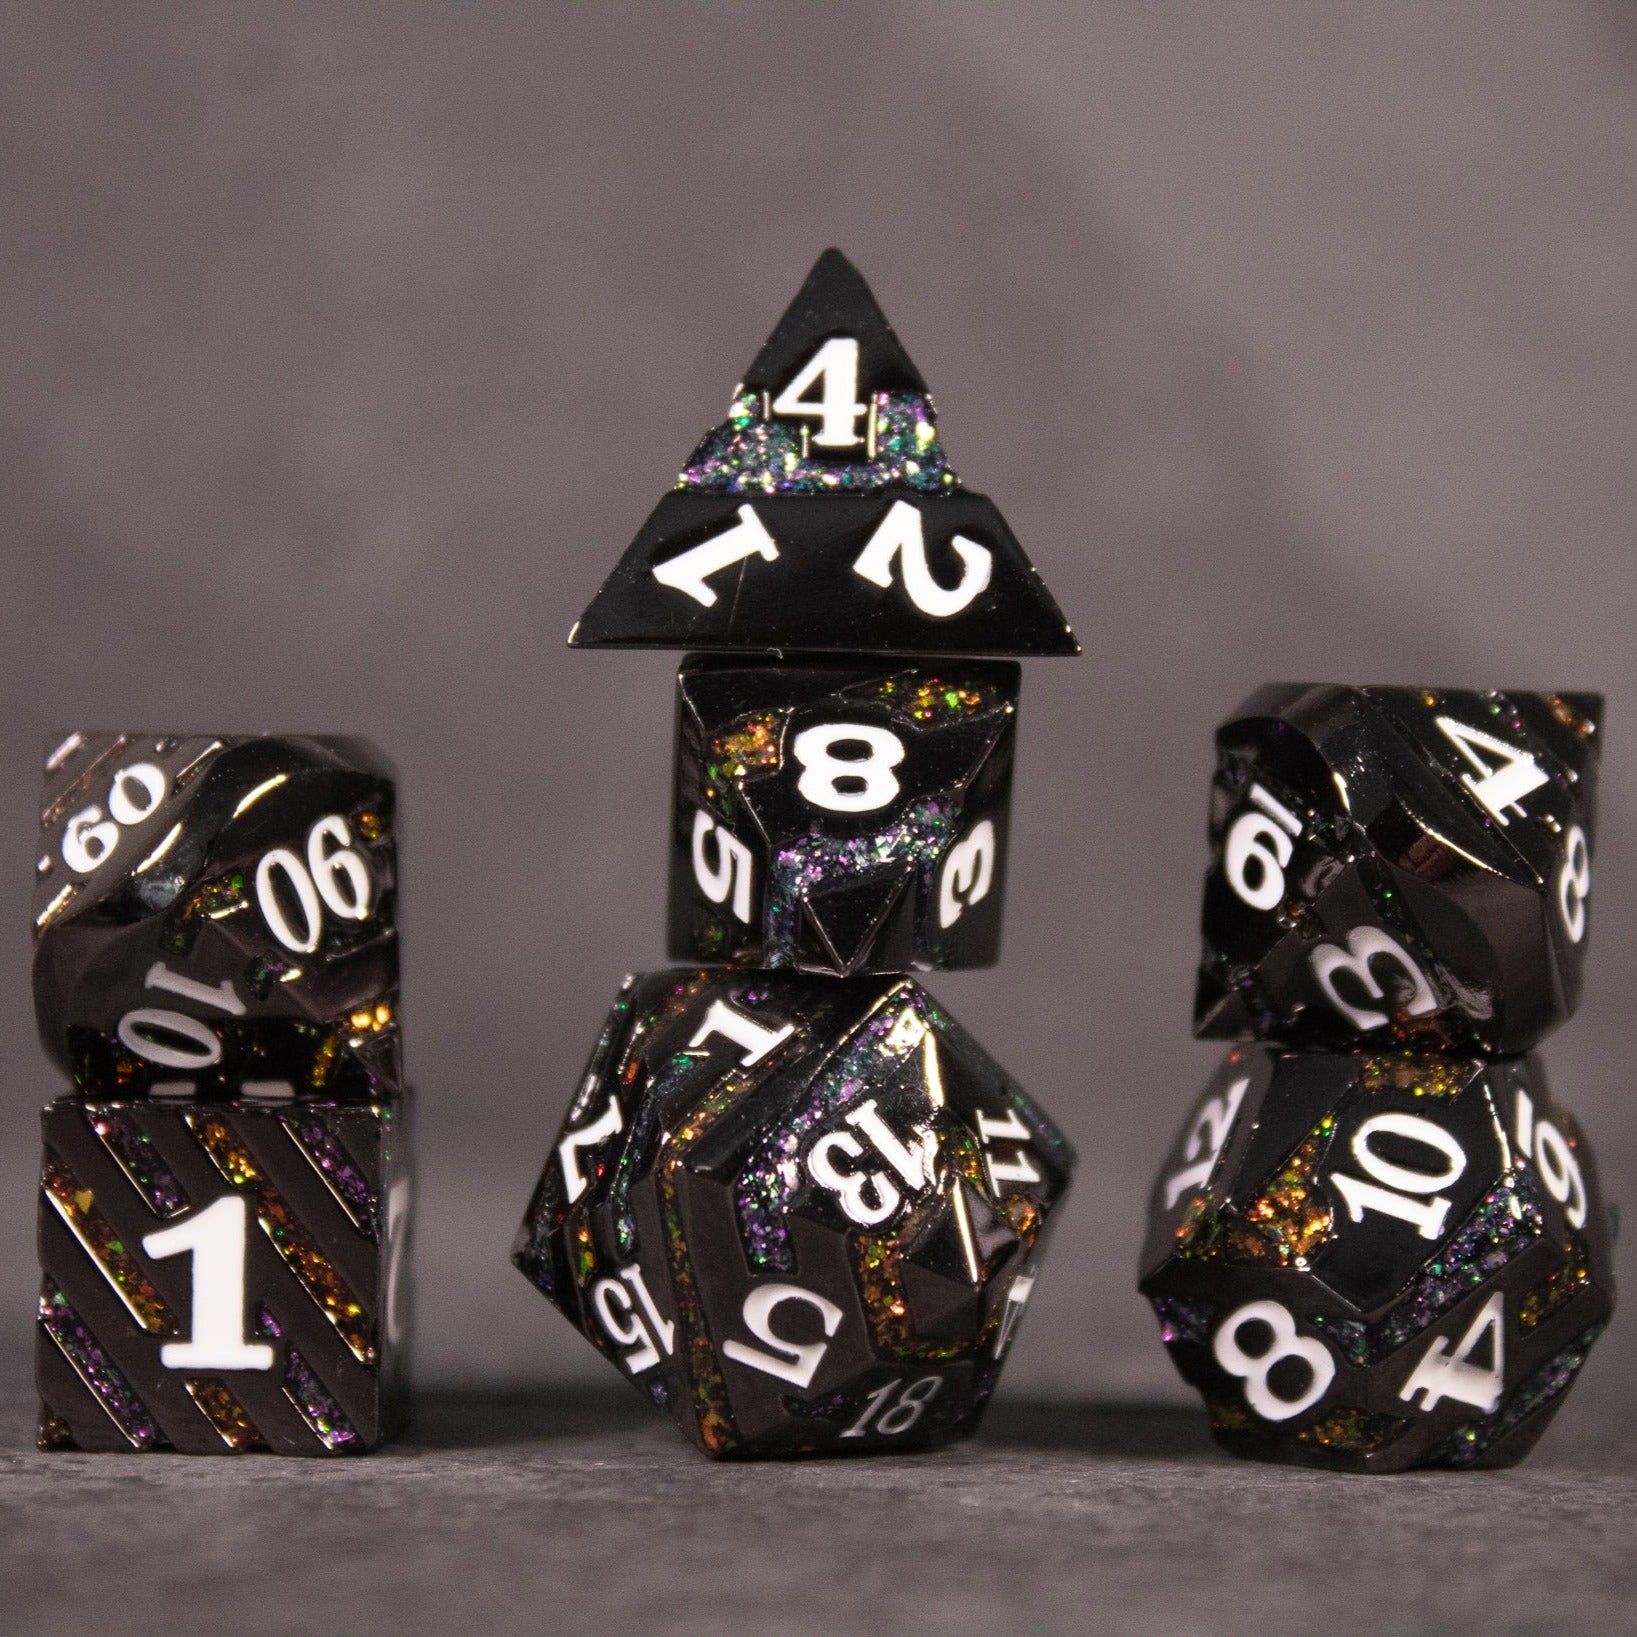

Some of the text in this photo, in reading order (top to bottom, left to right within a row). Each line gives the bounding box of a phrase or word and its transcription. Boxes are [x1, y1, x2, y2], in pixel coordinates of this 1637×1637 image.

[773, 338, 868, 446] 4
[652, 503, 780, 608] 1
[853, 500, 992, 617] 2
[793, 723, 905, 813] 8
[1435, 716, 1550, 826] 4
[692, 809, 752, 924] 5
[939, 820, 994, 929] 3
[1560, 825, 1590, 944] 8
[117, 961, 247, 1069] 10
[688, 999, 796, 1067] 1
[1310, 925, 1438, 1031] 3
[559, 1094, 624, 1204] 7
[807, 1099, 939, 1227] 13
[975, 1108, 1041, 1198] 11
[1330, 1112, 1468, 1241] 10
[142, 1195, 273, 1371] 1
[594, 1263, 675, 1375] 15
[722, 1283, 843, 1389] 5
[839, 1375, 943, 1438] 18
[1213, 1300, 1336, 1423] 8
[1400, 1291, 1504, 1414] 4
